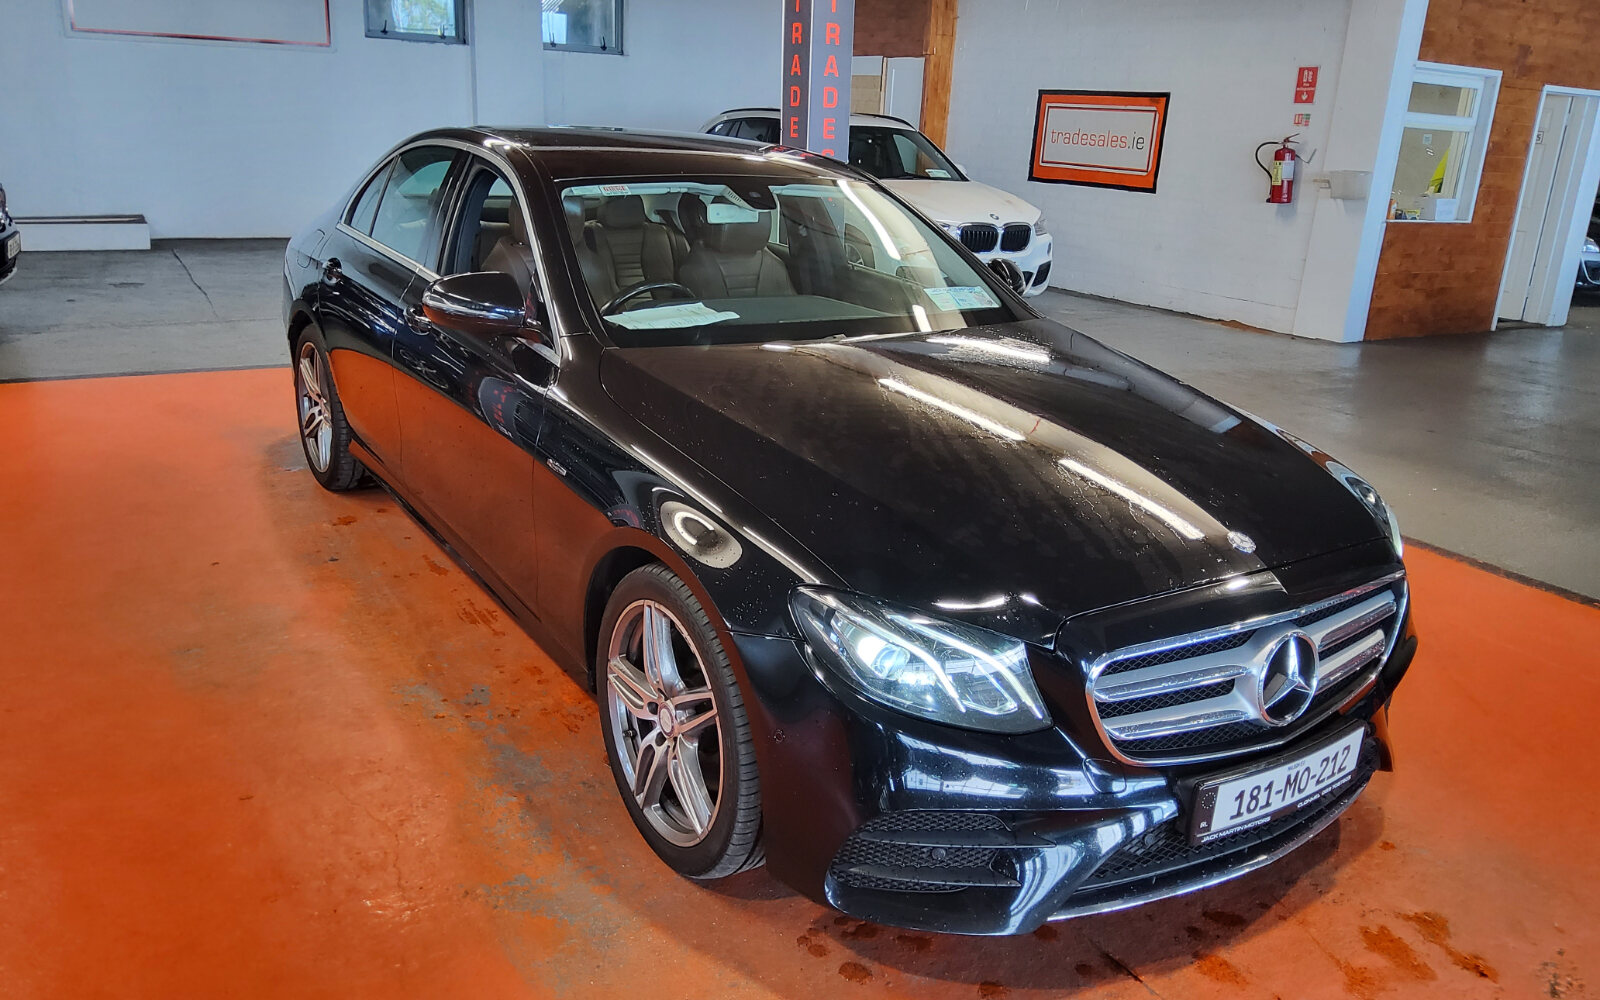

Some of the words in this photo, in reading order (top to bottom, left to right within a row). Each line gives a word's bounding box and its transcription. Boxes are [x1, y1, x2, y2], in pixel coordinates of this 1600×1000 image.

[1050, 128, 1145, 150] tradesales.ie
[1229, 744, 1352, 821] 181-MO-212
[1201, 833, 1219, 843] JACK
[1219, 826, 1244, 838] MARTIN
[1244, 816, 1271, 831] MOTORS
